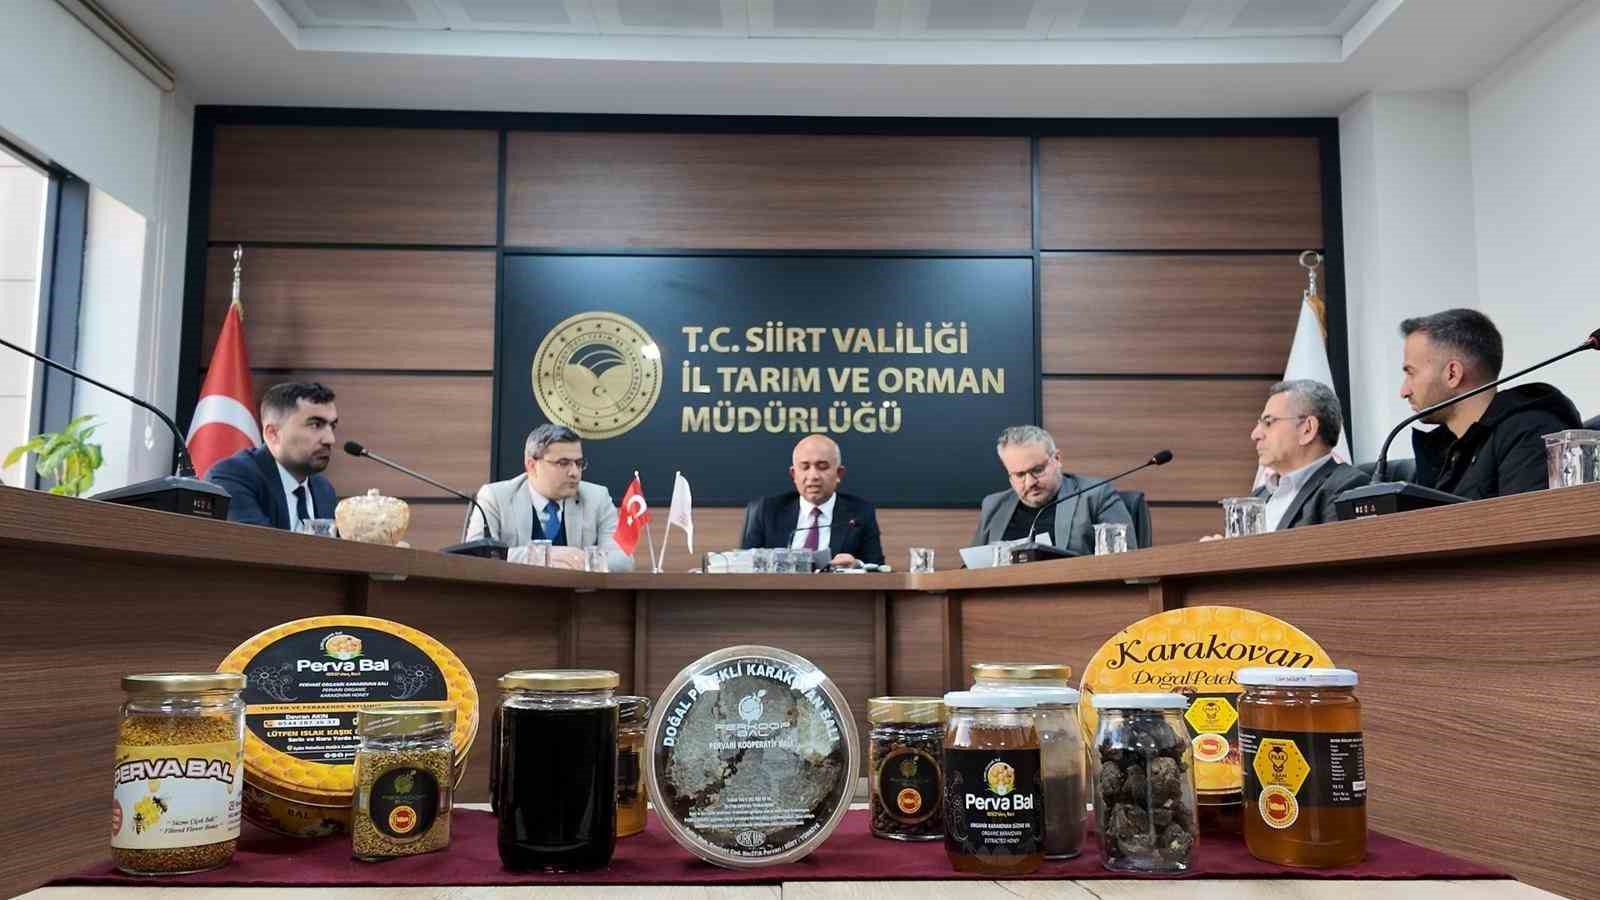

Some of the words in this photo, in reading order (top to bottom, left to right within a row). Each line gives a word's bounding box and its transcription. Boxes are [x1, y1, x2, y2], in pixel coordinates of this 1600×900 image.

[682, 326, 739, 354] T.C.
[745, 320, 827, 353] SİİRT
[832, 320, 968, 354] VALİLİĞİ
[682, 359, 710, 394] İL
[717, 368, 821, 394] TARIM
[827, 368, 870, 394] VE
[878, 367, 1005, 394] ORMAN
[682, 401, 901, 433] MÜDÜRLÜĞÜ
[296, 659, 355, 673] Perva
[359, 658, 390, 672] Bal
[1106, 634, 1314, 670] Karakovan
[1132, 670, 1195, 688] Doğal
[663, 701, 692, 748] DOĞAL
[820, 708, 840, 741] BALI
[185, 757, 234, 785] BAL
[965, 793, 1011, 811] Perva
[1013, 793, 1034, 810] Bal
